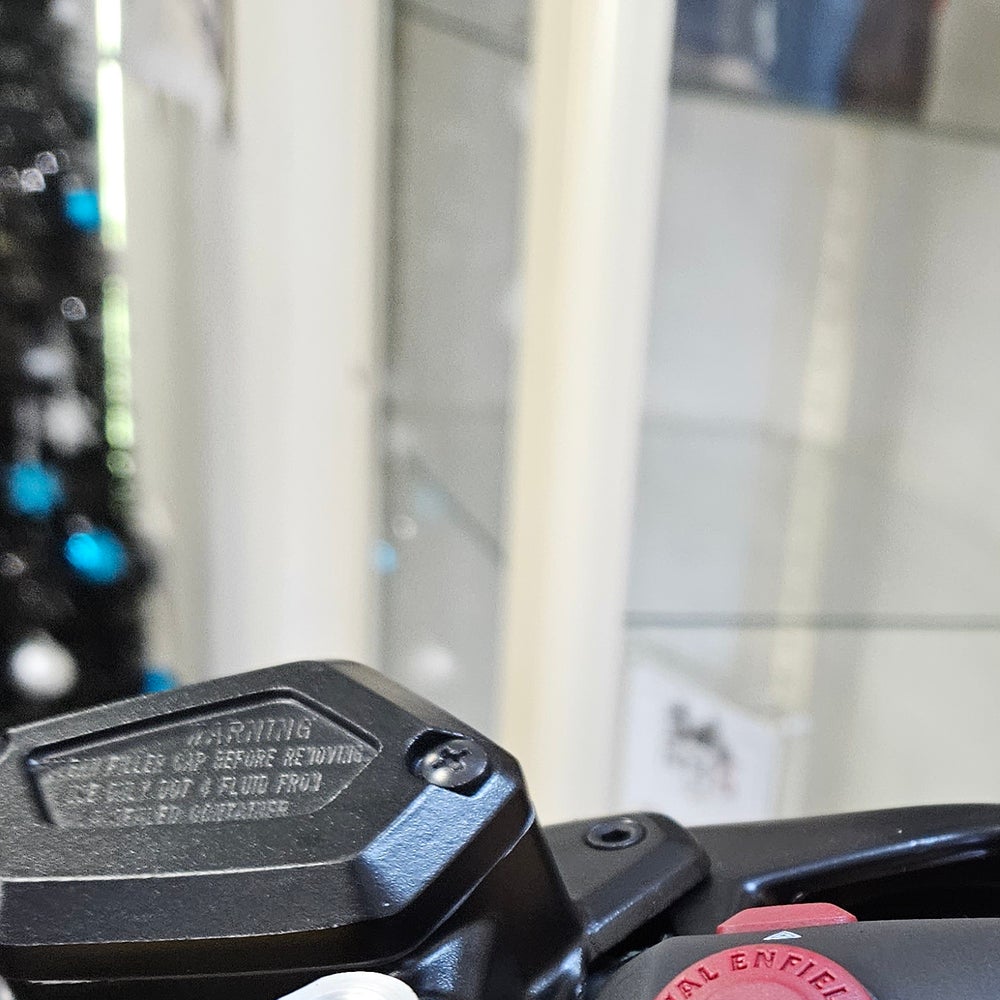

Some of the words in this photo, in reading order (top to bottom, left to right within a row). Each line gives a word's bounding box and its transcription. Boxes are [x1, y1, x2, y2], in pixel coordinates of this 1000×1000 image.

[187, 717, 313, 746] WARNING
[213, 746, 278, 770] BEFORE
[218, 774, 270, 796] FLUID
[275, 769, 323, 794] FROM
